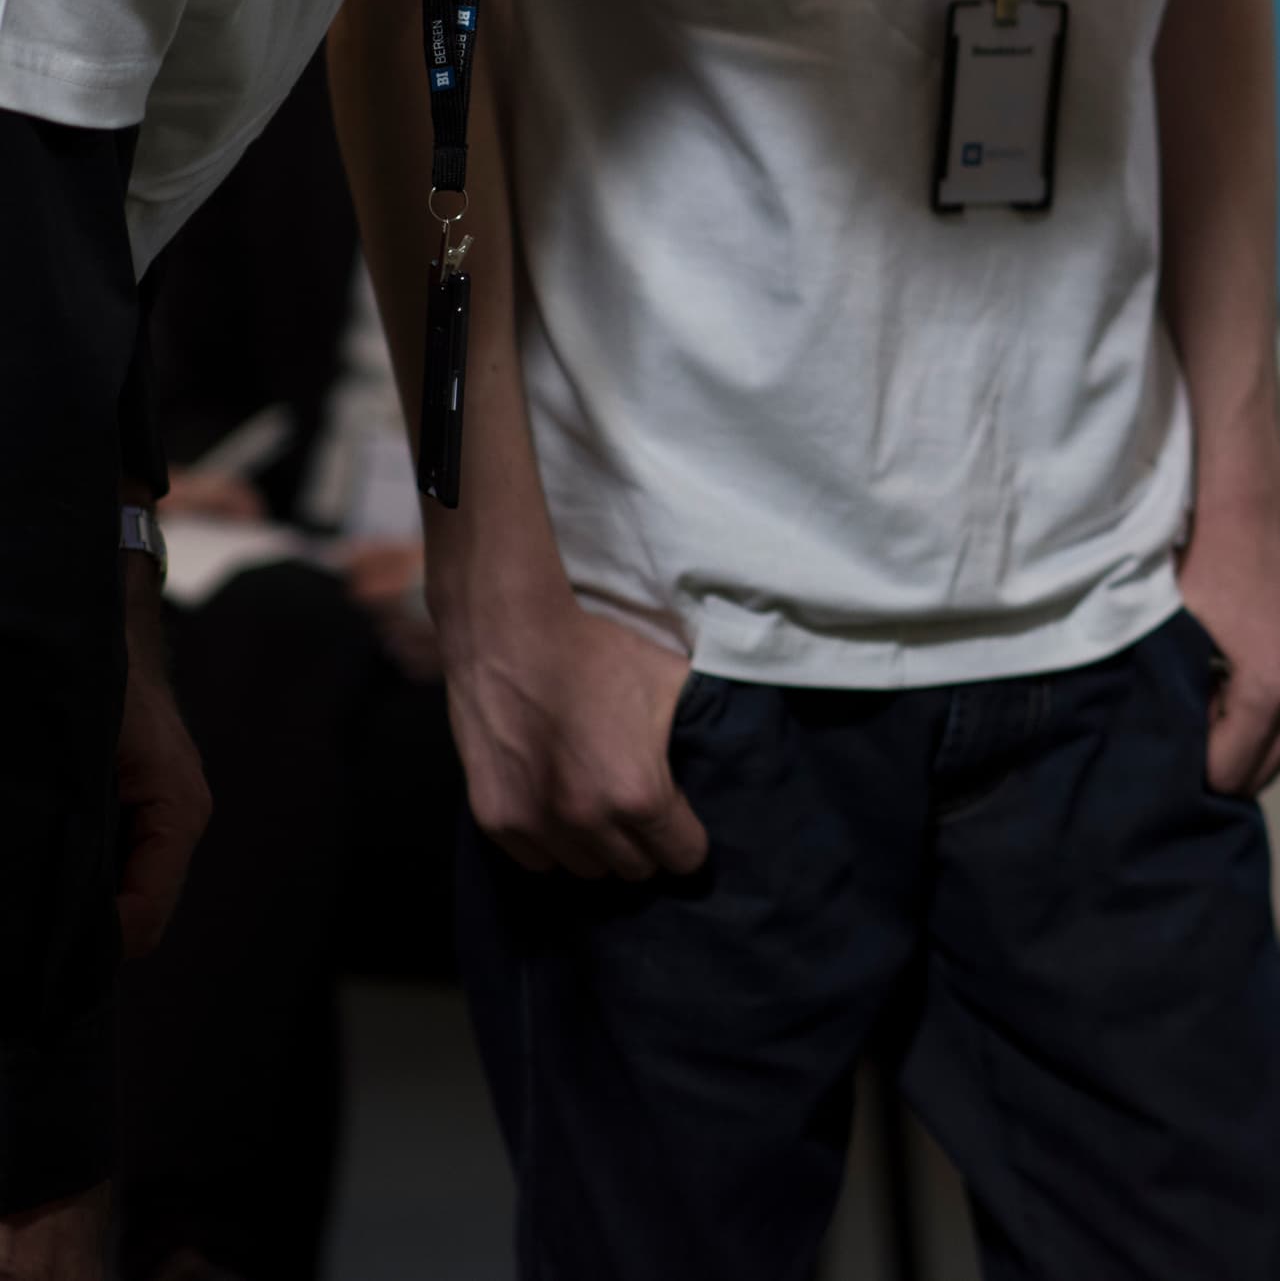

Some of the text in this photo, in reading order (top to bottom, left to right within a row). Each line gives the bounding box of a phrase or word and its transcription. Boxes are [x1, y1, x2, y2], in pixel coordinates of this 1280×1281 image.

[458, 10, 471, 26] BI
[432, 20, 450, 86] BI BERGEN
